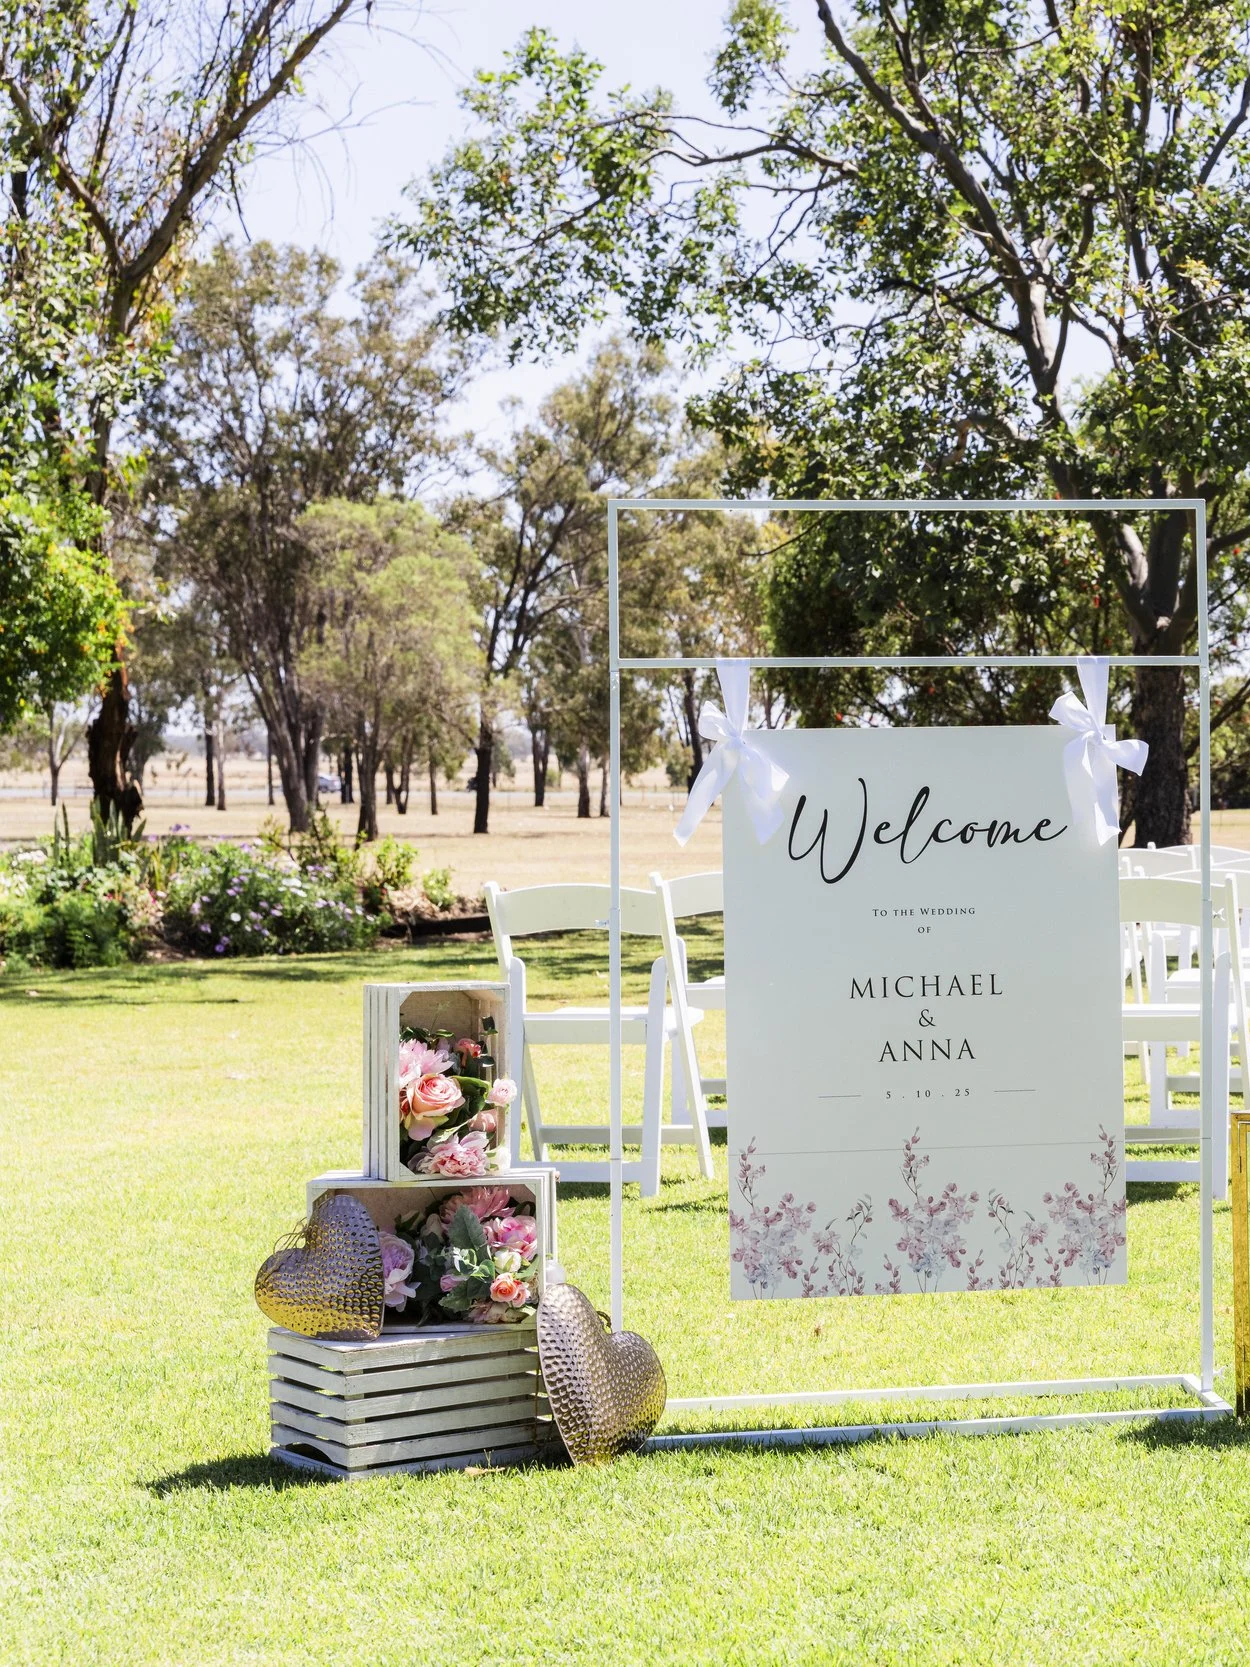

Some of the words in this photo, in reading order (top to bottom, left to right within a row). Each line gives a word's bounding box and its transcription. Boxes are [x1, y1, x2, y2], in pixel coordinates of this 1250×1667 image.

[788, 778, 1068, 884] Welcome
[850, 974, 1003, 999] MICHAEL
[918, 1009, 936, 1027] &
[878, 1038, 977, 1063] ANNA
